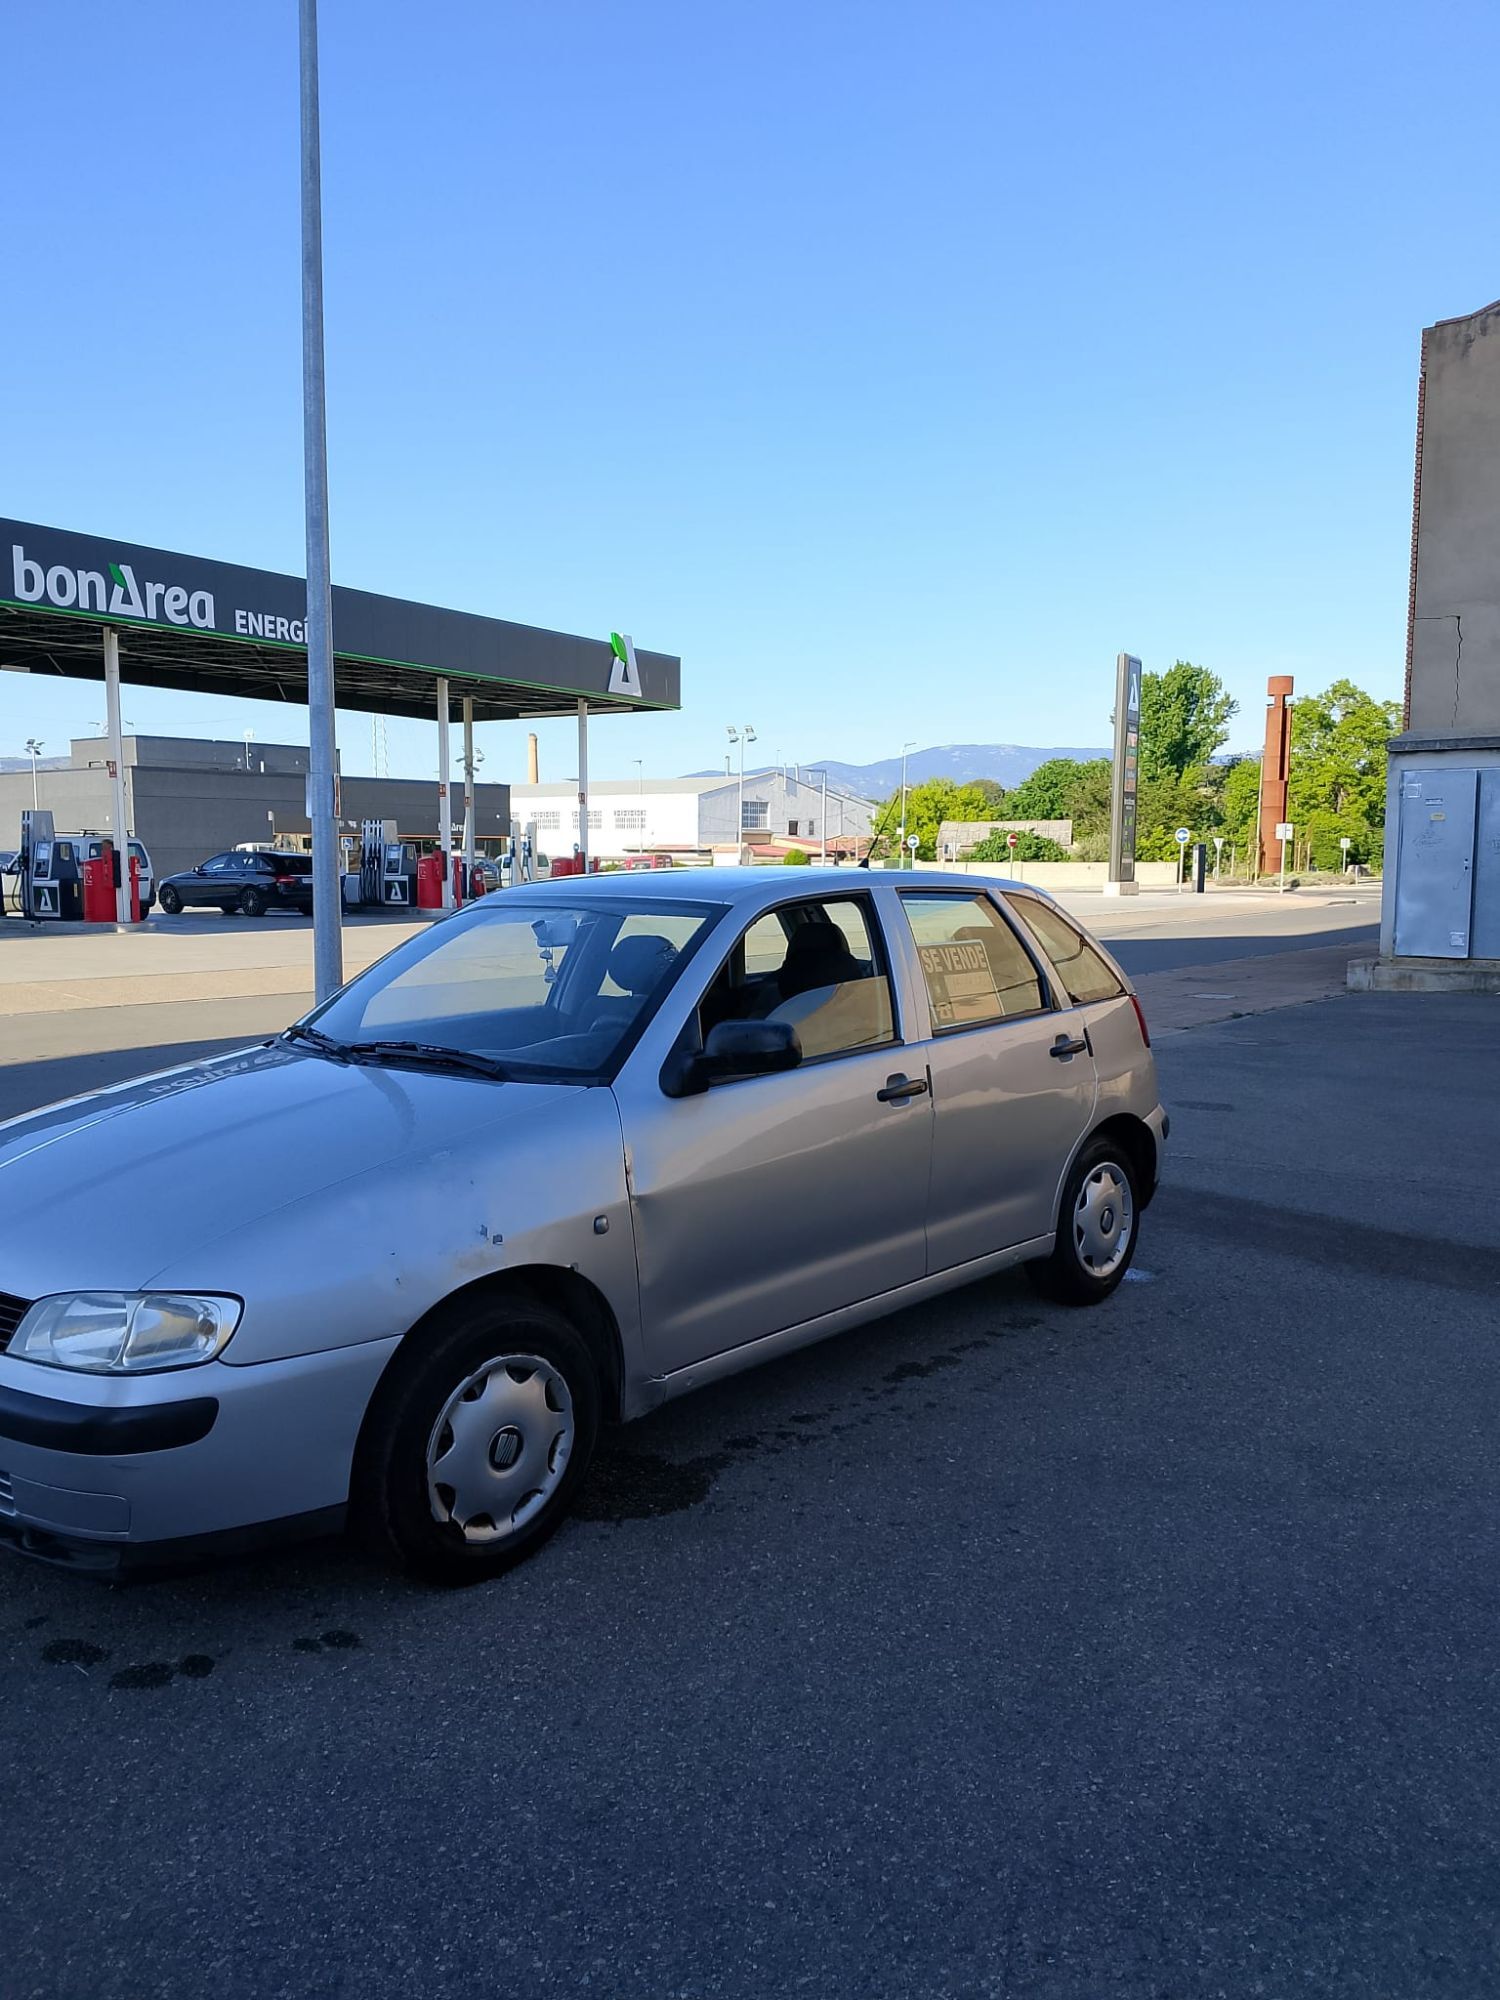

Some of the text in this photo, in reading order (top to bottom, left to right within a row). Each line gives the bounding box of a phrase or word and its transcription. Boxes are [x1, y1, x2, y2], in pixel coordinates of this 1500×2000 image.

[13, 545, 308, 643] bonArea ENERGÍ
[921, 945, 987, 974] SE VENDE
